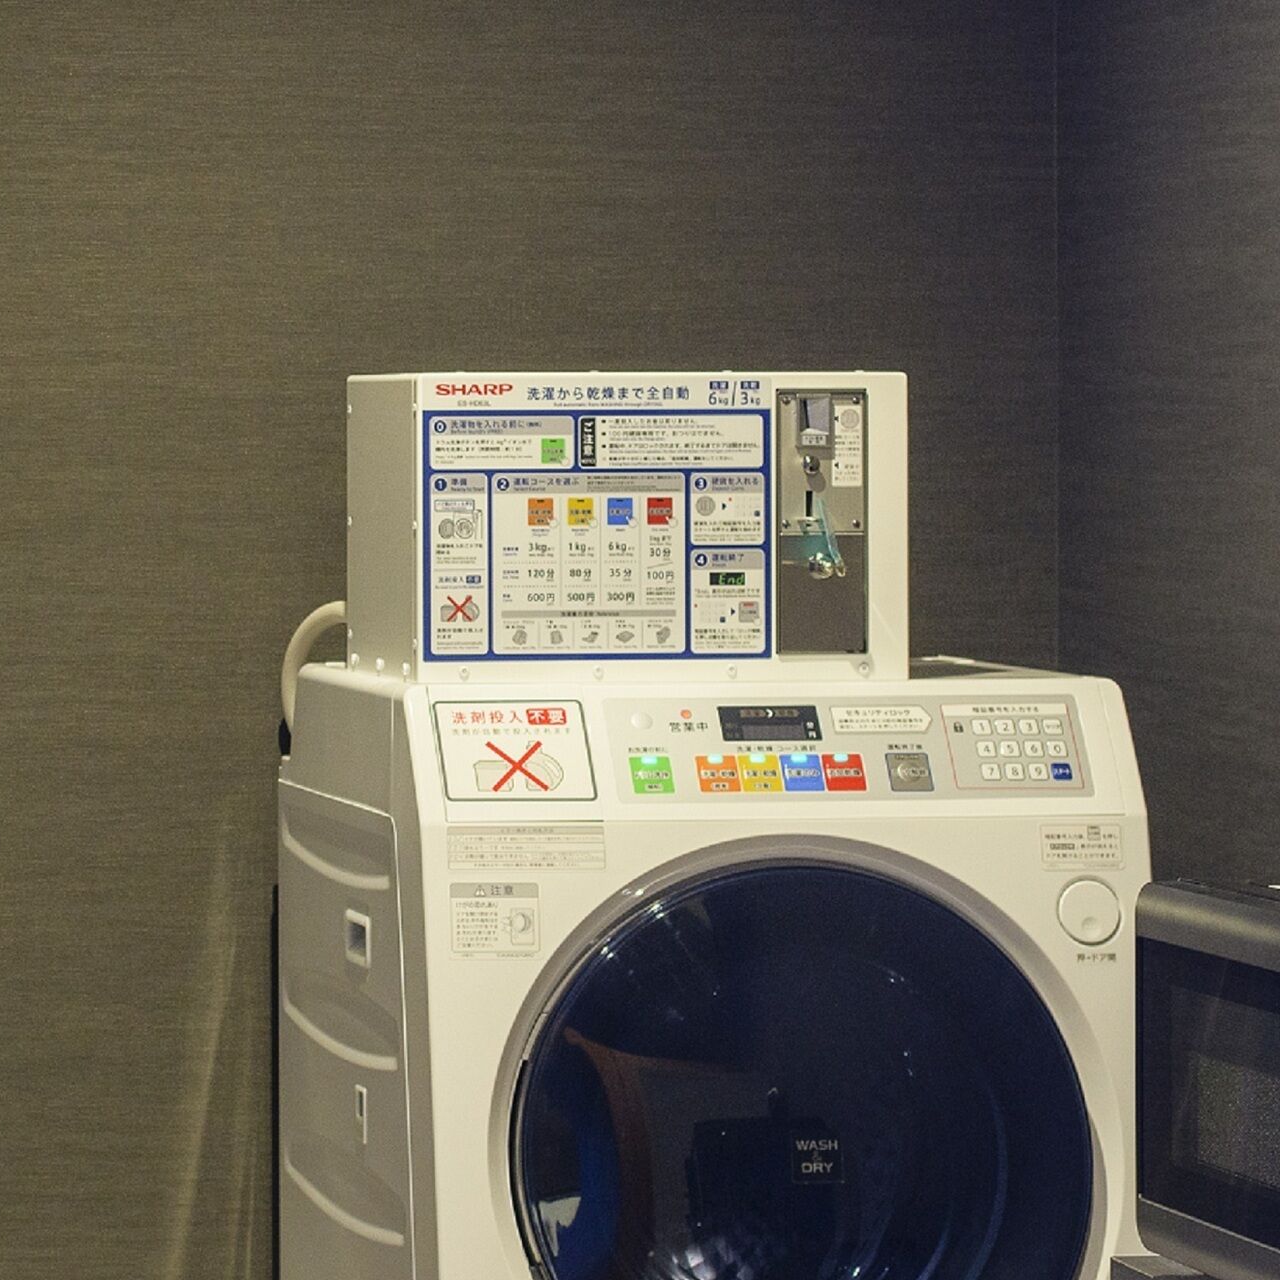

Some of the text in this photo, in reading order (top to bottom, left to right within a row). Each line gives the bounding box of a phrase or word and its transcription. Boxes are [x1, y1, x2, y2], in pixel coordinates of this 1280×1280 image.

[435, 383, 513, 396] SHARP
[527, 387, 690, 400] 洗濯から乾燥まで全自動
[513, 477, 580, 486] 運転コースを選ぶ
[711, 553, 745, 562] 運転終了
[528, 569, 555, 578] 120分
[569, 569, 592, 578] 80分
[609, 568, 632, 577] 35分
[646, 571, 674, 580] 100円
[718, 574, 744, 584] End
[527, 593, 555, 602] 600円
[567, 593, 595, 602] 500円
[607, 593, 635, 602] 300円
[451, 709, 566, 725] 洗剤投入 不要
[669, 722, 709, 733] 営業中
[978, 722, 985, 732] 1
[1002, 722, 1009, 732] 2
[1026, 722, 1033, 732] 3
[983, 745, 990, 754] 4
[1007, 745, 1014, 754] 5
[1030, 744, 1037, 754] 6
[988, 767, 995, 776] 7
[1011, 767, 1019, 776] 8
[1034, 767, 1042, 776] 9
[795, 1139, 838, 1151] WASH
[801, 1162, 833, 1173] DRY
